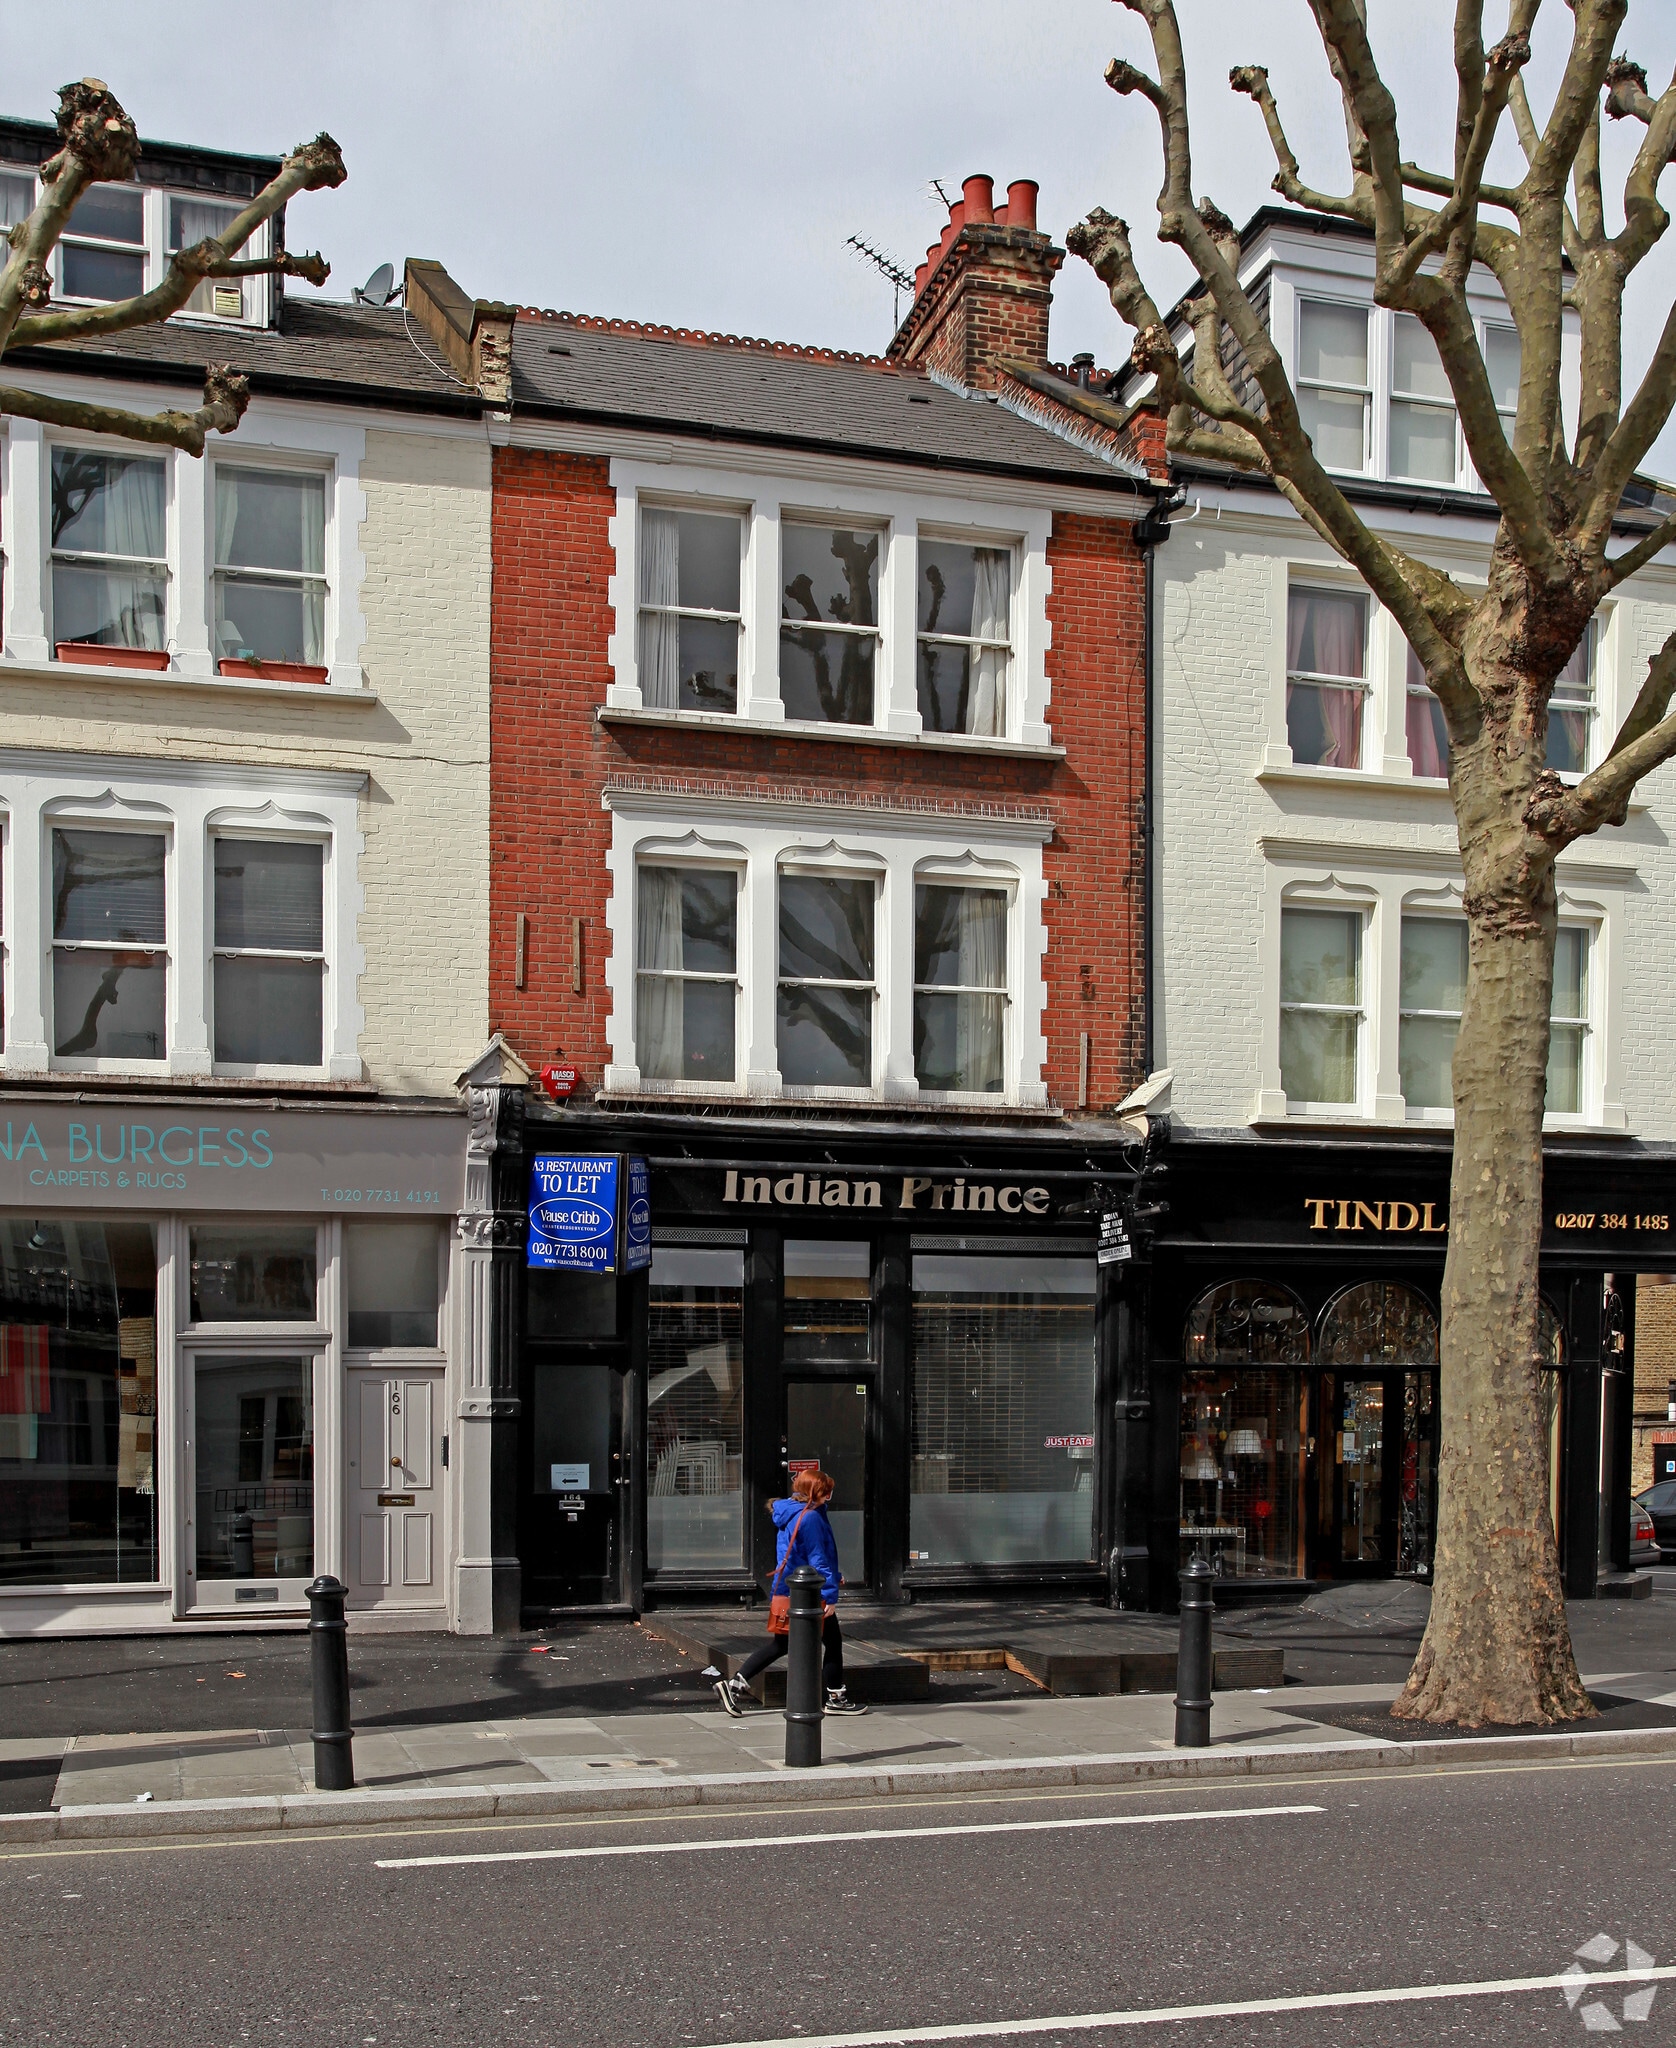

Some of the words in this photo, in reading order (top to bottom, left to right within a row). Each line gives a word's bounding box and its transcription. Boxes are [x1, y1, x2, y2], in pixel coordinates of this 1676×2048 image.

[551, 1070, 575, 1080] MASCO
[68, 1123, 274, 1169] BURGESS
[532, 1161, 544, 1172] A3
[546, 1161, 613, 1173] RESTAURANT
[29, 1169, 110, 1187] CARPETS
[117, 1172, 130, 1188] &
[136, 1172, 187, 1189] RUGS
[541, 1174, 562, 1193] TO
[566, 1175, 601, 1194] LET
[320, 1188, 331, 1201] T:
[334, 1189, 362, 1202] 020
[366, 1189, 400, 1202] 7731
[406, 1190, 440, 1203] 4191
[722, 1170, 883, 1207] Indian
[899, 1177, 1050, 1214] Prince
[540, 1209, 569, 1223] Vause
[570, 1210, 600, 1225] Cribb
[1304, 1198, 1450, 1232] TINDL
[1555, 1213, 1596, 1229] 0207
[1599, 1213, 1628, 1229] 384
[1633, 1214, 1669, 1230] 1485
[532, 1242, 552, 1255] 020
[554, 1244, 578, 1257] 7731
[580, 1246, 607, 1260] 8001
[392, 1380, 401, 1415] 166
[1046, 1437, 1069, 1446] JUST
[1069, 1437, 1087, 1446] EAT
